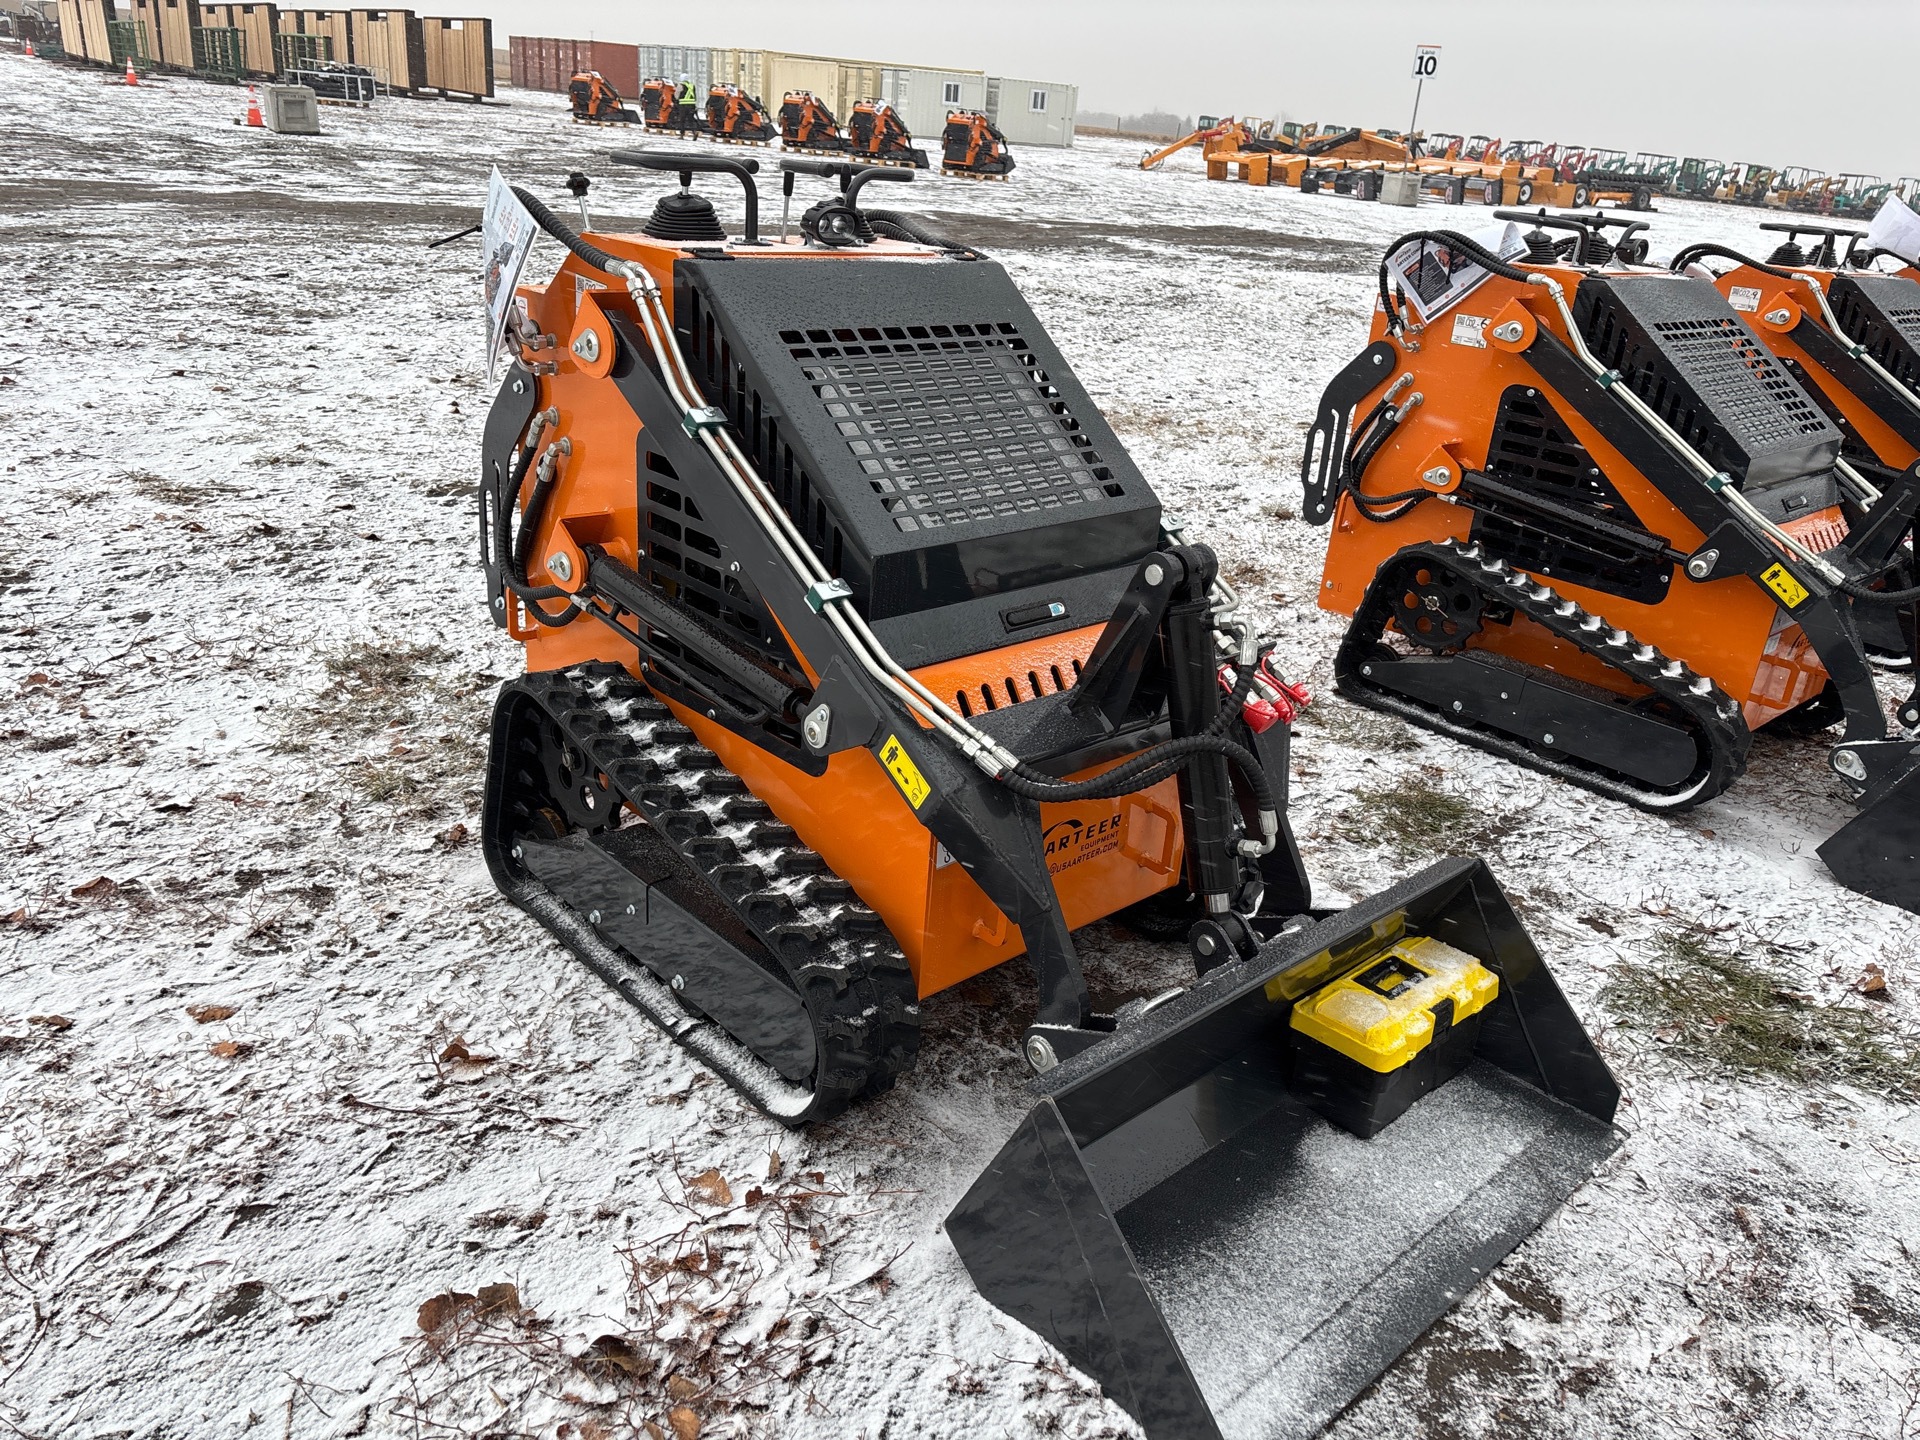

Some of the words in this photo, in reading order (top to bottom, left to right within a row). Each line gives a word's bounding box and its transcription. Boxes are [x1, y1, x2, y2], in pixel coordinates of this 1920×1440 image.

[1415, 55, 1437, 76] 10
[1045, 814, 1121, 856] ARTEER
[1080, 830, 1119, 852] EQUIPMENT
[1048, 840, 1119, 877] @USAARTEER.COM
